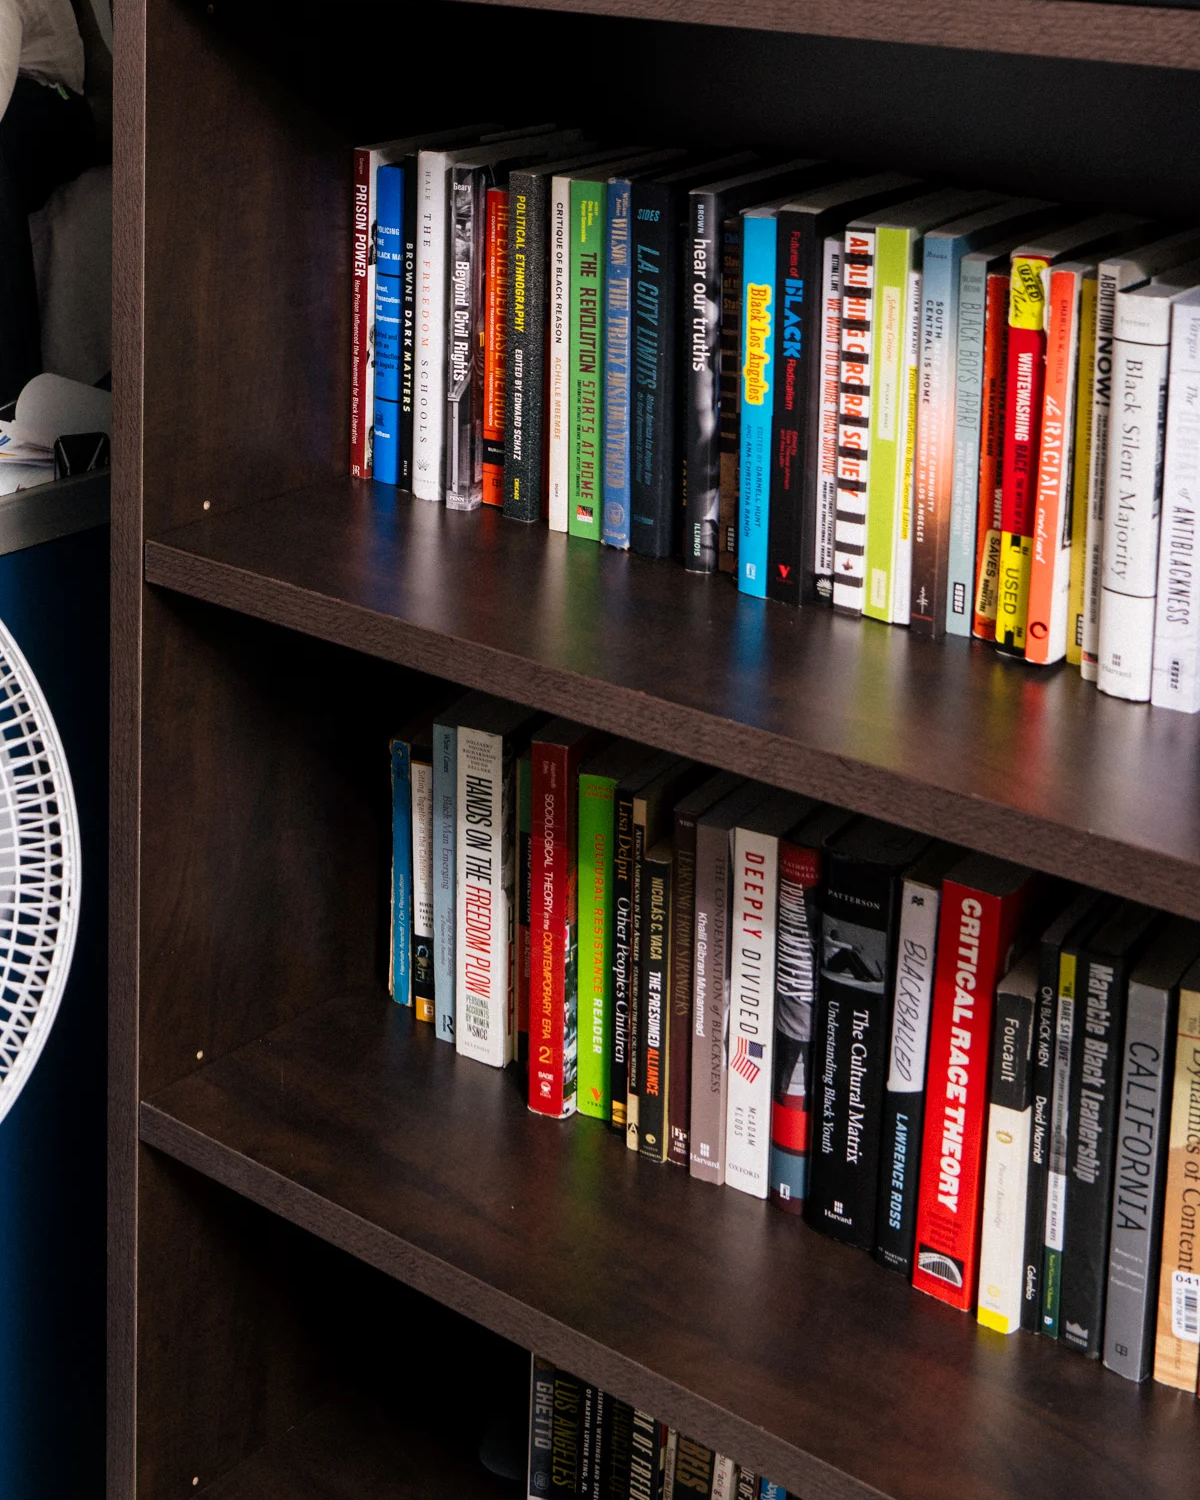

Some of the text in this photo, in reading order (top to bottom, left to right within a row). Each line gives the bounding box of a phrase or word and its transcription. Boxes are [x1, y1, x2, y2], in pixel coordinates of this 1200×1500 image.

[355, 184, 367, 277] PRISON POWER
[453, 182, 472, 193] Geary
[697, 204, 705, 234] BROWN
[515, 195, 526, 333] POLITICAL ETHNOGRAPHY
[555, 267, 563, 301] BLACK
[556, 250, 563, 264] OF
[580, 252, 597, 278] THE
[636, 280, 659, 326] CITY
[637, 244, 660, 274] L.A.
[692, 239, 711, 372] hear our truths
[1020, 268, 1040, 299] USED
[1099, 274, 1116, 335] ABOLITION
[403, 243, 413, 413] BROWNE DARK MATTERS
[420, 213, 432, 443] THE FREEDOM SCHOOLS
[450, 261, 469, 381] Beyond Civil Rights
[579, 287, 597, 373] REVOLUTION
[636, 326, 658, 389] LIMITS
[746, 288, 767, 403] Black Los Angeles
[1096, 336, 1113, 407] NOW!
[582, 380, 595, 434] STARTS
[582, 440, 595, 458] AT
[1013, 352, 1033, 474] WHITEWASHING RACE
[581, 461, 594, 499] HOME
[1111, 359, 1143, 580] Black Silent Majority
[1003, 567, 1019, 615] USED
[1166, 506, 1195, 625] ANTIBLACKNESS
[465, 774, 492, 999] HANDS ON THE FREEDOM PLOW
[541, 793, 554, 1040] SOCIOLOGICAL THEORY CONTEMPORARY ERA
[650, 923, 663, 931] C.
[592, 833, 604, 1054] CULTURAL RESISTANCE READER
[612, 897, 630, 1063] Other People's Children
[650, 936, 662, 960] VACA
[739, 851, 765, 1035] DEEPLY DIVIDED
[952, 898, 982, 1023] CRITICAL
[646, 971, 661, 1096] THE PRESUMED ALLIANCE
[894, 938, 928, 1082] BLACKBALLED
[1000, 1017, 1019, 1083] Foucault
[821, 1000, 840, 1155] Understanding Black Youth
[846, 1009, 869, 1165] The Cultural Matrix
[946, 1026, 972, 1104] RACE
[1073, 962, 1113, 1184] Marable Black Leadership
[888, 1112, 908, 1230] LAWRENCE ROSS
[937, 1107, 966, 1213] THEORY
[1116, 1041, 1159, 1231] CALIFORNIA
[535, 1381, 553, 1449] GHETTO
